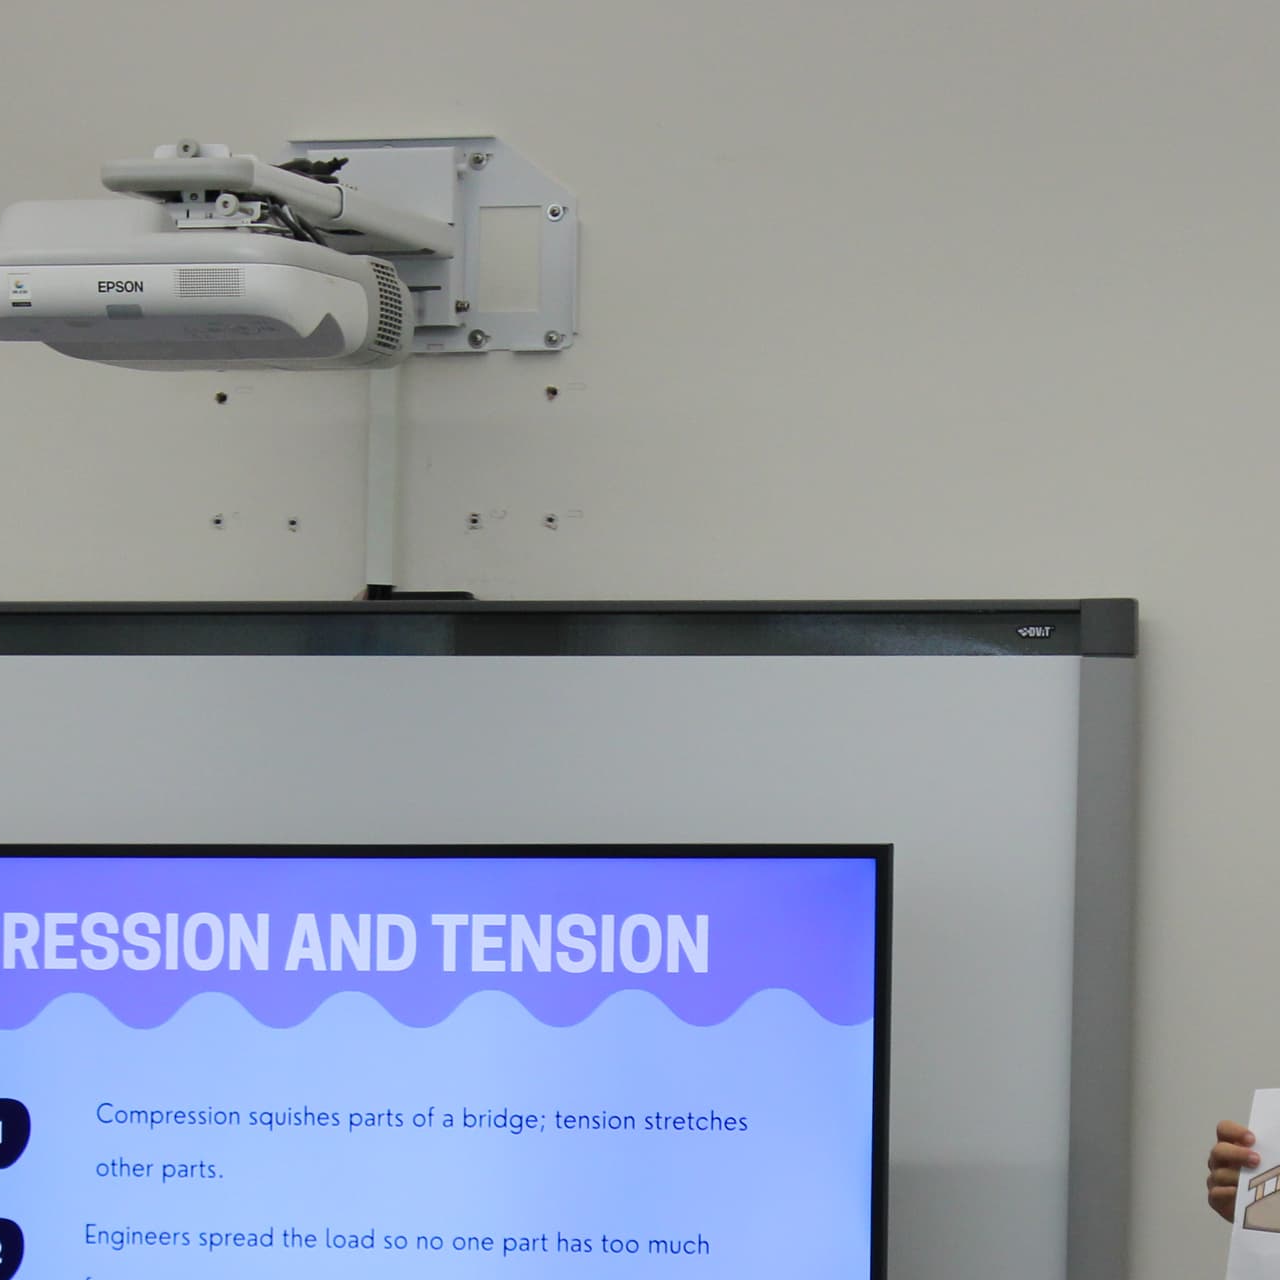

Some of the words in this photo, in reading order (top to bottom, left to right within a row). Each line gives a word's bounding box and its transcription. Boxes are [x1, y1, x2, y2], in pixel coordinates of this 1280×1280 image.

[97, 281, 144, 294] EPSON
[285, 913, 416, 972] AND
[431, 913, 709, 973] TENSION
[96, 1102, 240, 1130] Compression
[249, 1105, 340, 1132] squishes
[349, 1108, 404, 1133] parts
[412, 1106, 435, 1128] of
[442, 1113, 454, 1128] a
[463, 1107, 546, 1135] bridge;
[555, 1110, 636, 1130] tension
[644, 1110, 748, 1132] stretches
[96, 1157, 154, 1178] other
[162, 1160, 223, 1184] parts.
[85, 1223, 190, 1251] Engineers
[199, 1226, 273, 1252] spread
[282, 1227, 317, 1248] the
[325, 1227, 375, 1249] load
[384, 1235, 408, 1249] so
[416, 1236, 444, 1250] no
[452, 1236, 494, 1251] one
[503, 1233, 548, 1258] part
[557, 1231, 593, 1254] has
[601, 1234, 640, 1254] too
[648, 1233, 710, 1255] much
